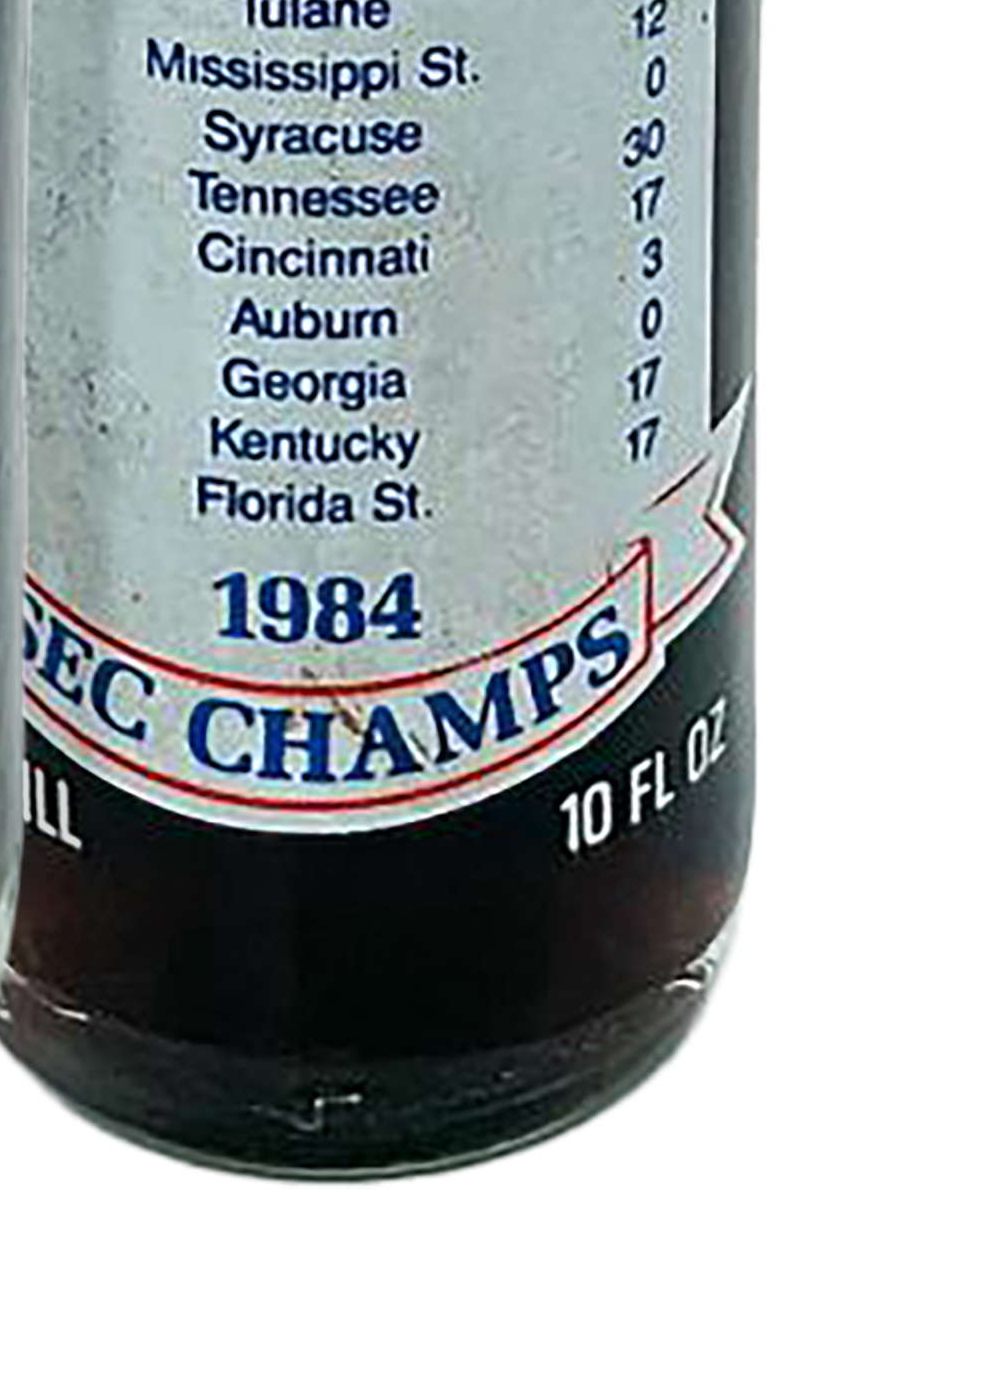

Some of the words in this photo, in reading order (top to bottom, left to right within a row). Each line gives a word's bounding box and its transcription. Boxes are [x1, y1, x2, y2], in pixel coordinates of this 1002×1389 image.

[146, 37, 399, 100] Mississippi
[418, 46, 480, 87] St.
[646, 56, 666, 98] 0
[204, 108, 423, 163] Syracuse
[623, 118, 667, 167] 30
[188, 168, 440, 218] Tennessee
[633, 177, 665, 223] 17
[197, 232, 430, 278] Cincinnati
[642, 237, 662, 279] 3
[230, 297, 397, 339] Auburn
[641, 298, 662, 340] 0
[222, 357, 406, 411] Georgia
[629, 356, 663, 403] 17
[210, 416, 421, 469] Kentucky
[628, 416, 661, 462] 17
[197, 476, 354, 523] Florida
[373, 480, 434, 522] St.
[213, 571, 422, 644] 1984
[187, 605, 632, 783] CHAMPS
[559, 780, 612, 853] 10
[630, 750, 677, 824] FL
[687, 694, 726, 784] OZ
